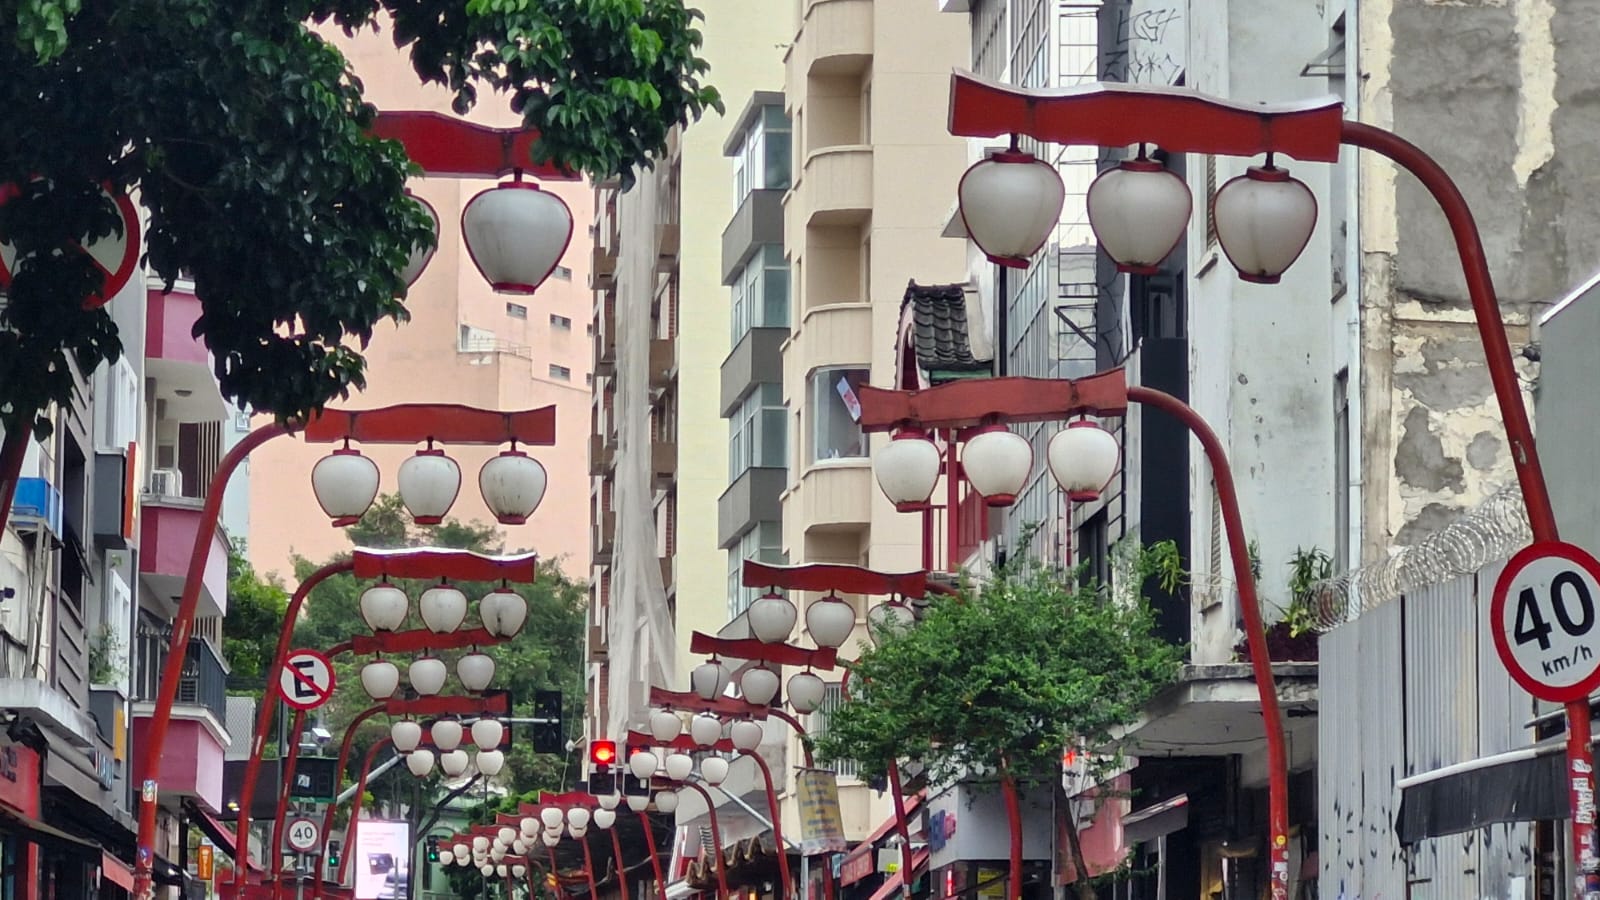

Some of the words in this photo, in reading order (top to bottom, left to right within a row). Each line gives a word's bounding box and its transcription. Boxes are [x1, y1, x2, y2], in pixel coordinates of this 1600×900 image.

[1514, 570, 1594, 651] 40
[1541, 645, 1593, 676] km/h
[292, 661, 317, 698] E
[294, 826, 313, 840] 40
